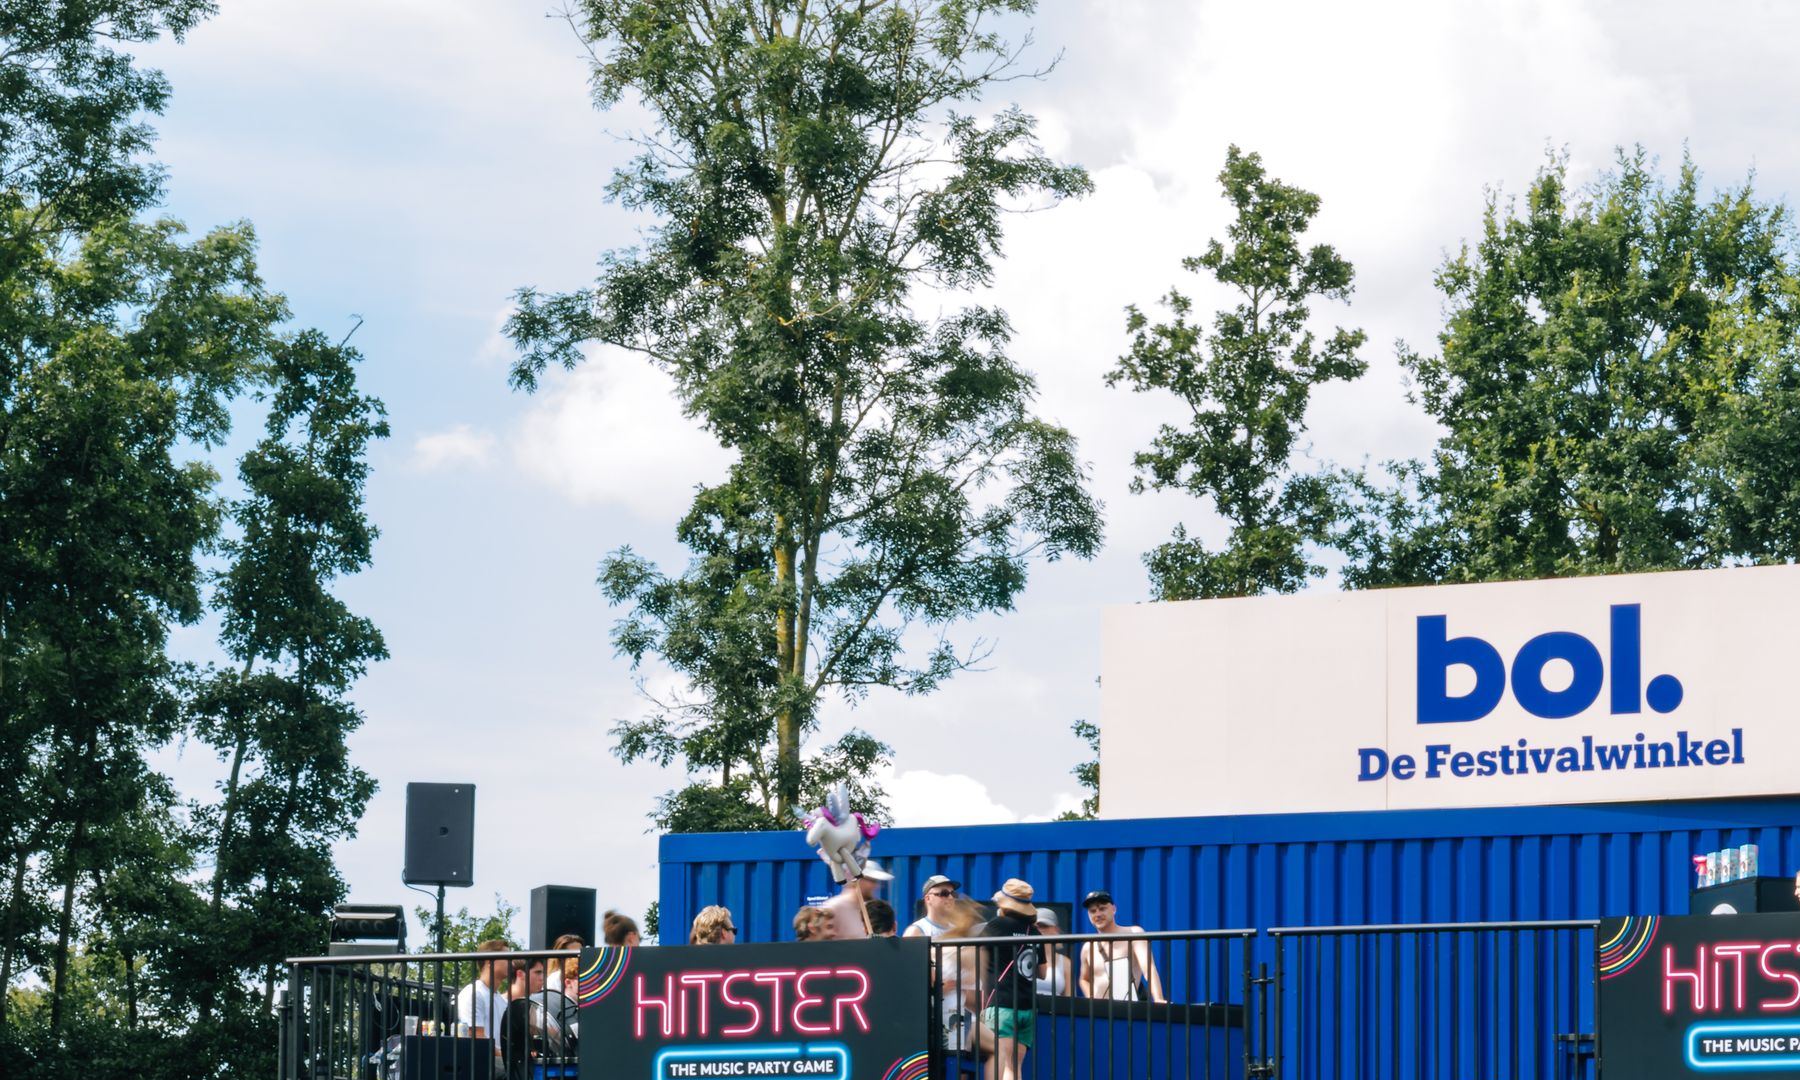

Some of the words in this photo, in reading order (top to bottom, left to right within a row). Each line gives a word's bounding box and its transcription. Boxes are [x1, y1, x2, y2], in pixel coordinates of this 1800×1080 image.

[1416, 603, 1684, 725] bol.
[1358, 747, 1416, 782] De
[1425, 728, 1745, 779] Festivalwinkel
[634, 966, 870, 1038] HITSTER
[669, 1063, 697, 1077] THE
[700, 1061, 745, 1076] MUSIC
[747, 1060, 791, 1074] PARTY
[792, 1059, 834, 1073] GAME
[1702, 1039, 1733, 1053] THE
[1736, 1037, 1786, 1052] MUSIC
